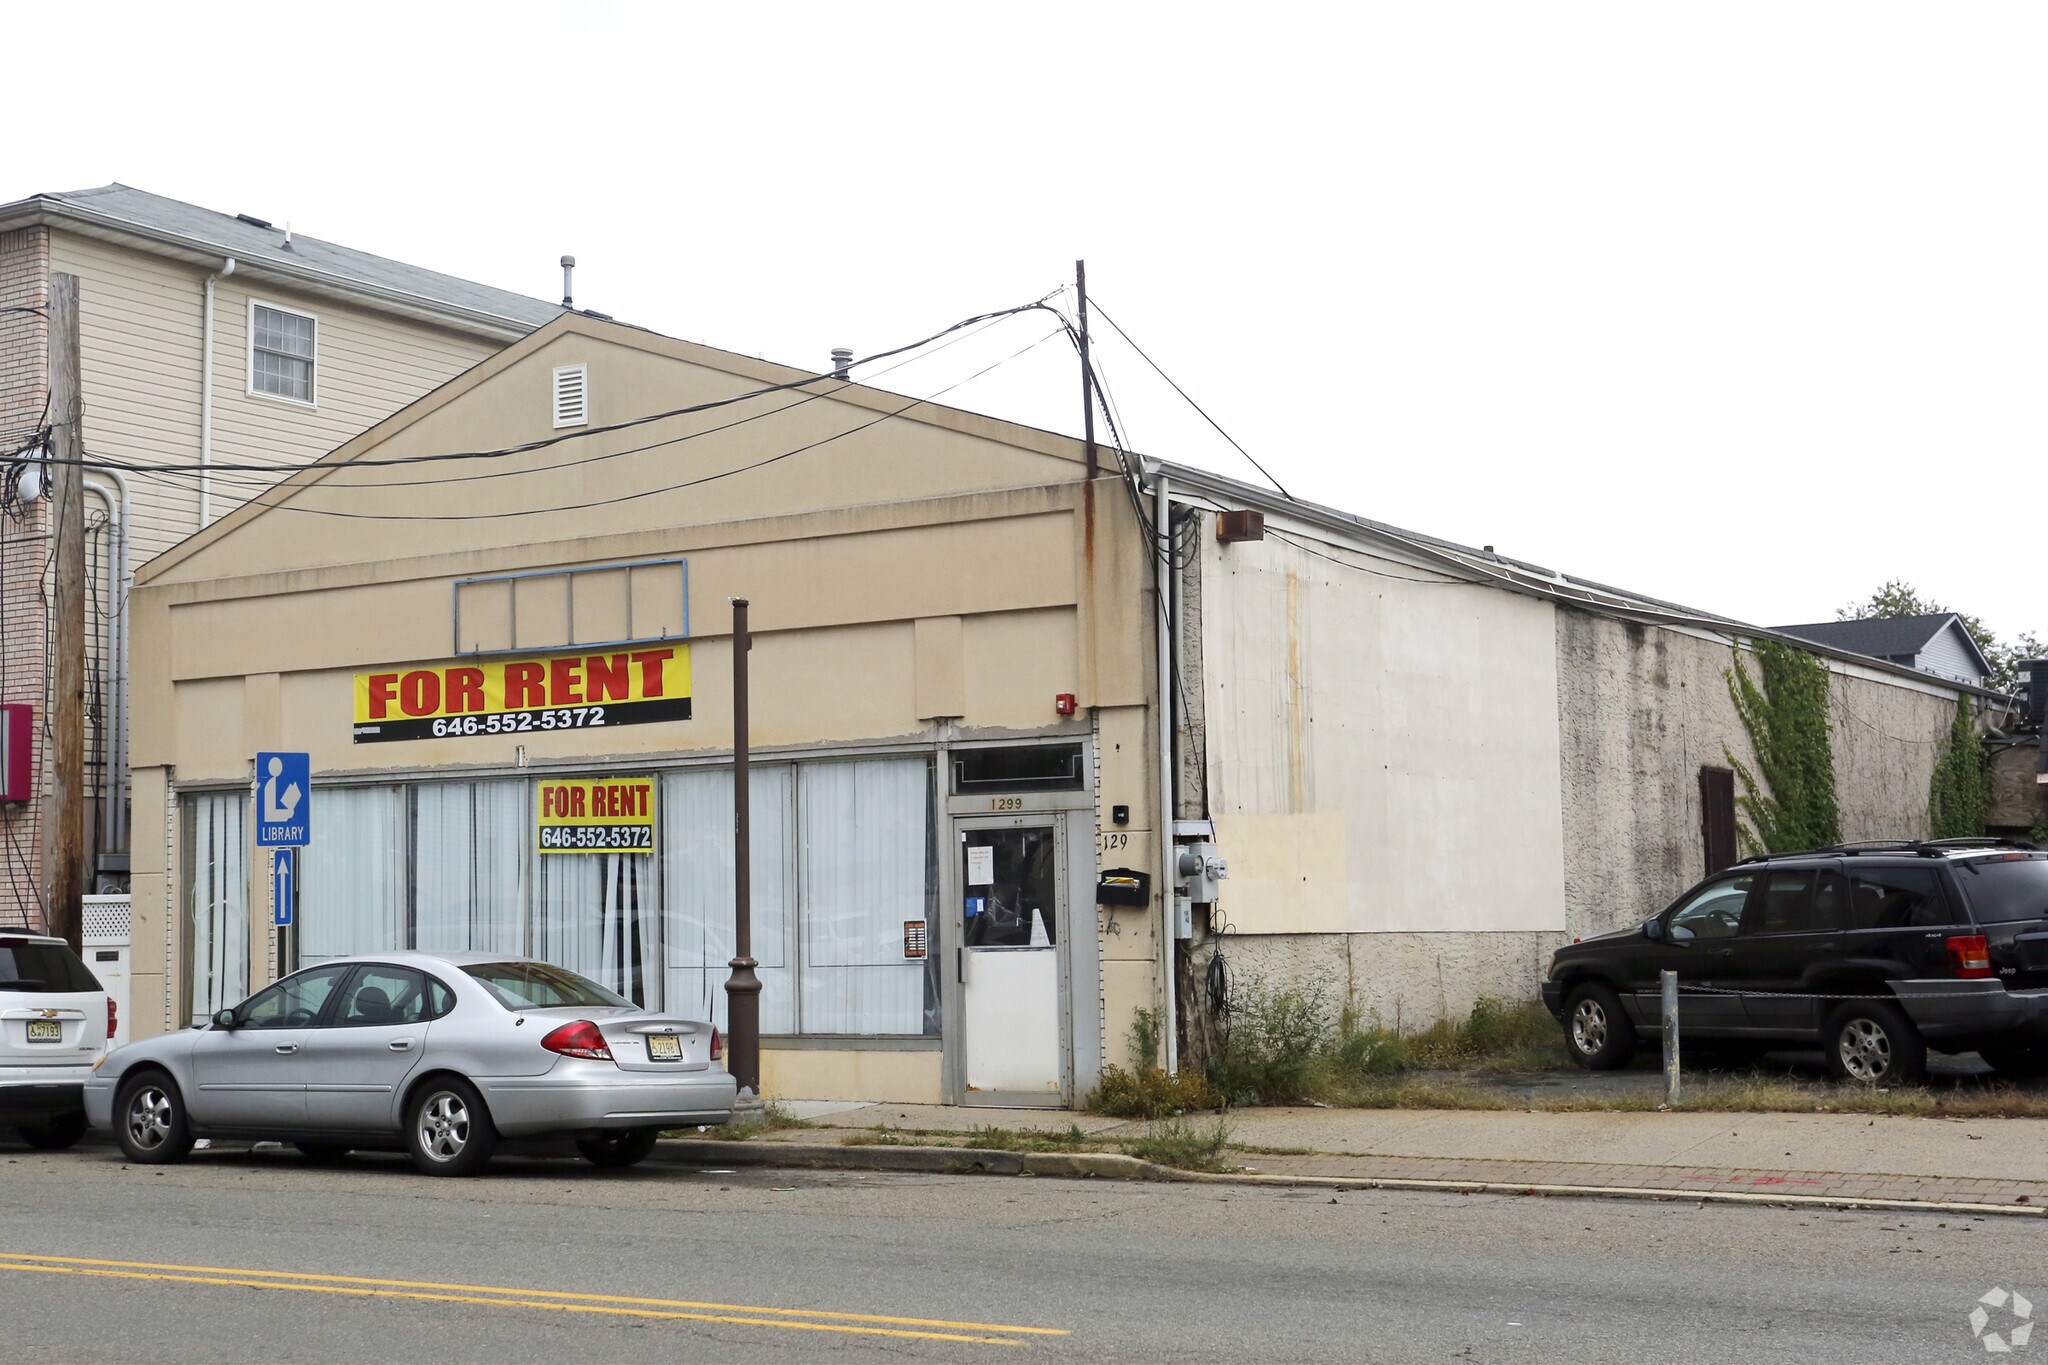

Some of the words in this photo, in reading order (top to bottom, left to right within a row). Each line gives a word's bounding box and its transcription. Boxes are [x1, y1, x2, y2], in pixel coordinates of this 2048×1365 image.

[368, 666, 486, 719] FOR
[504, 648, 675, 710] RENT
[432, 706, 606, 737] 646-552-5372
[543, 785, 586, 819] FOR
[591, 784, 650, 817] RENT
[991, 798, 1022, 810] 1299
[262, 826, 304, 842] LIBRARY
[541, 826, 651, 848] 646-552-5372
[1103, 833, 1128, 851] 129
[1999, 966, 2017, 976] Jeep
